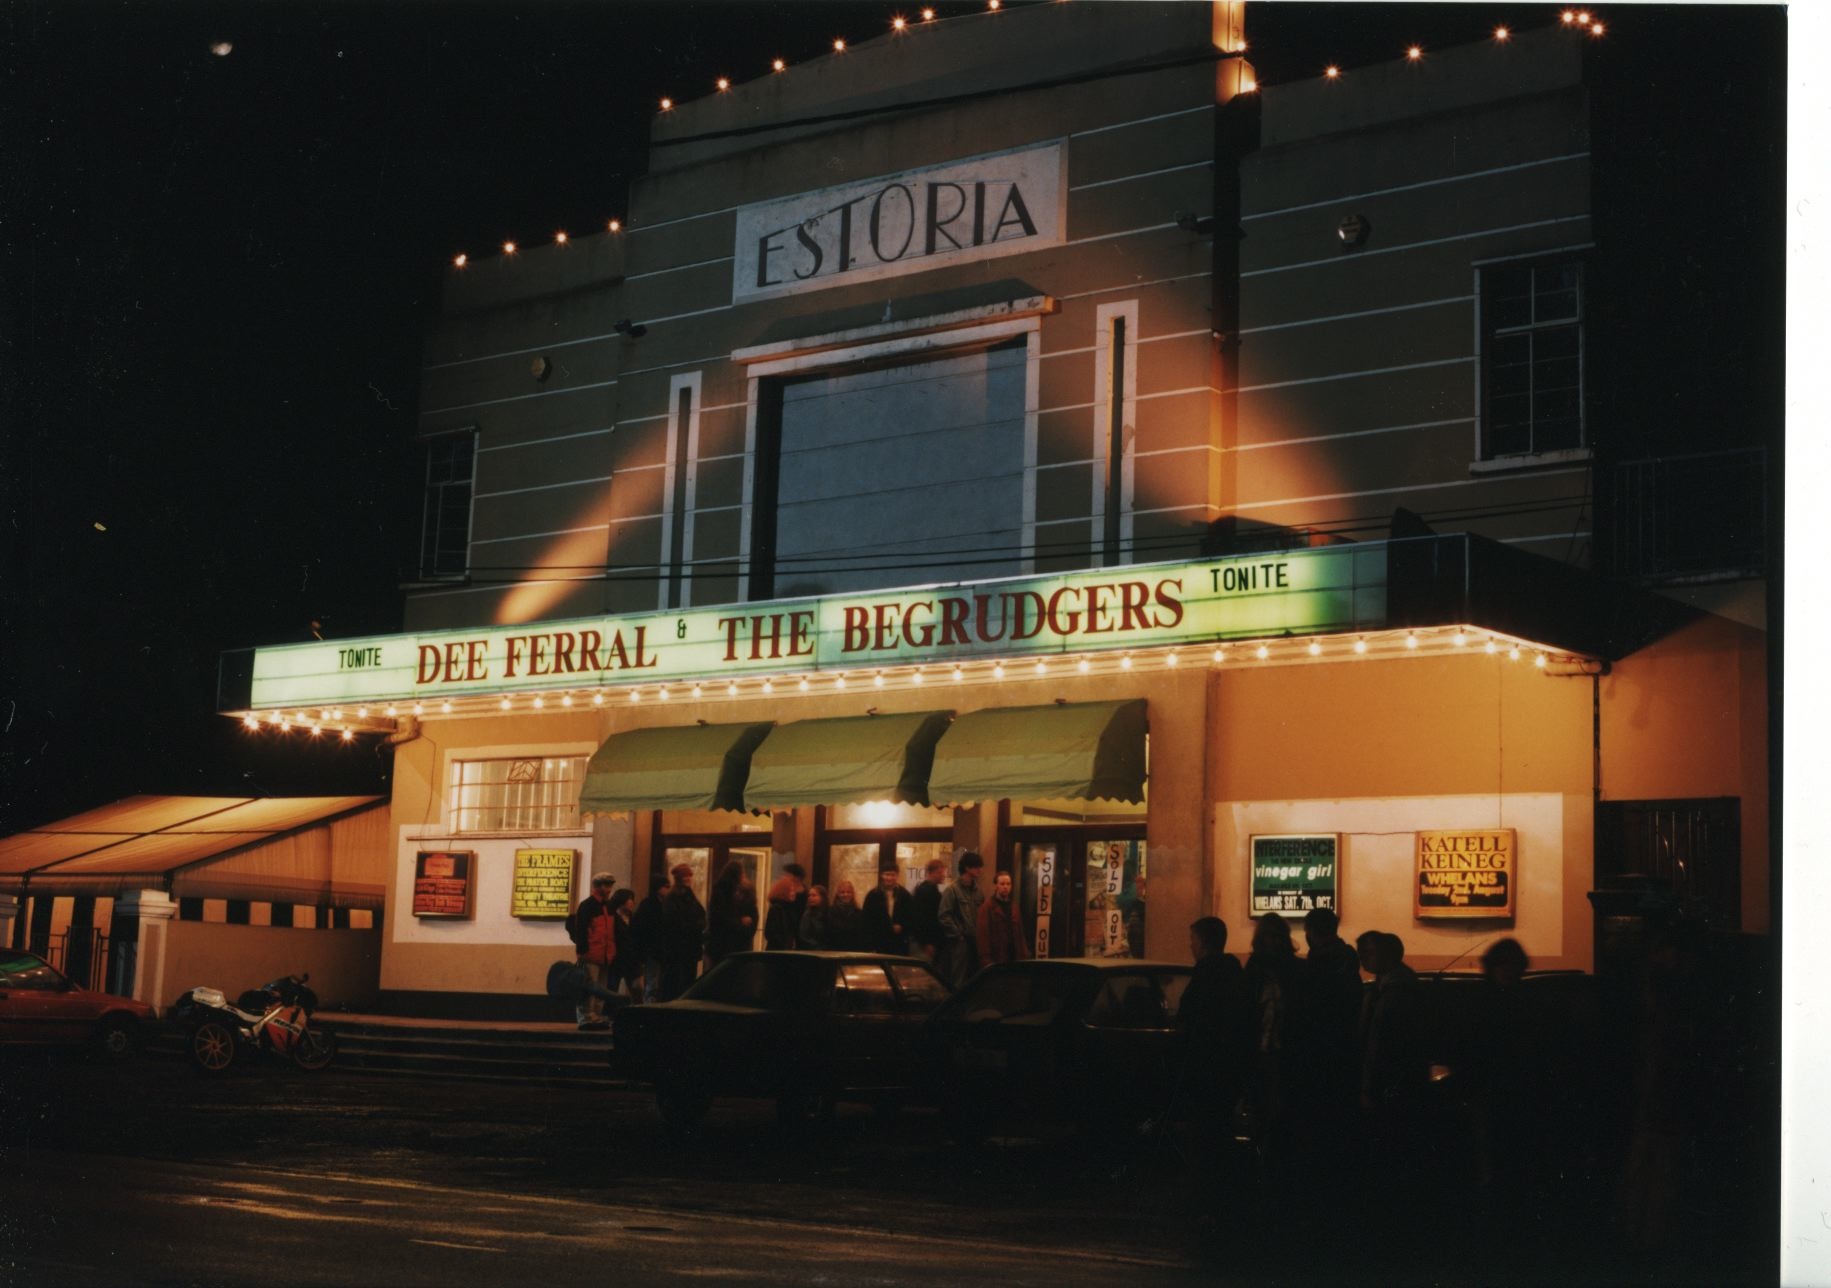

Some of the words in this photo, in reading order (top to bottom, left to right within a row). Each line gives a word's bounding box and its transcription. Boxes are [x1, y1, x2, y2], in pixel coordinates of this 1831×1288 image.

[757, 181, 1038, 287] ESTORIA
[338, 647, 382, 671] TONITE
[416, 639, 488, 685] DEE
[503, 625, 658, 679] FERRAL
[677, 619, 687, 640] &
[718, 610, 815, 661] THE
[842, 579, 1183, 653] BEGRUDGERS
[1210, 563, 1289, 594] TONITE
[1420, 836, 1507, 853] KATELL
[531, 855, 571, 868] FRAMES
[1107, 844, 1120, 893] SOLD
[1420, 853, 1506, 869] KEINEG
[1255, 864, 1303, 880] vinegar
[1307, 864, 1332, 880] girl
[1426, 872, 1498, 885] WHELANS
[1040, 857, 1052, 912] SOLD
[1255, 896, 1282, 910] WHELANS
[1109, 913, 1119, 945] OUT
